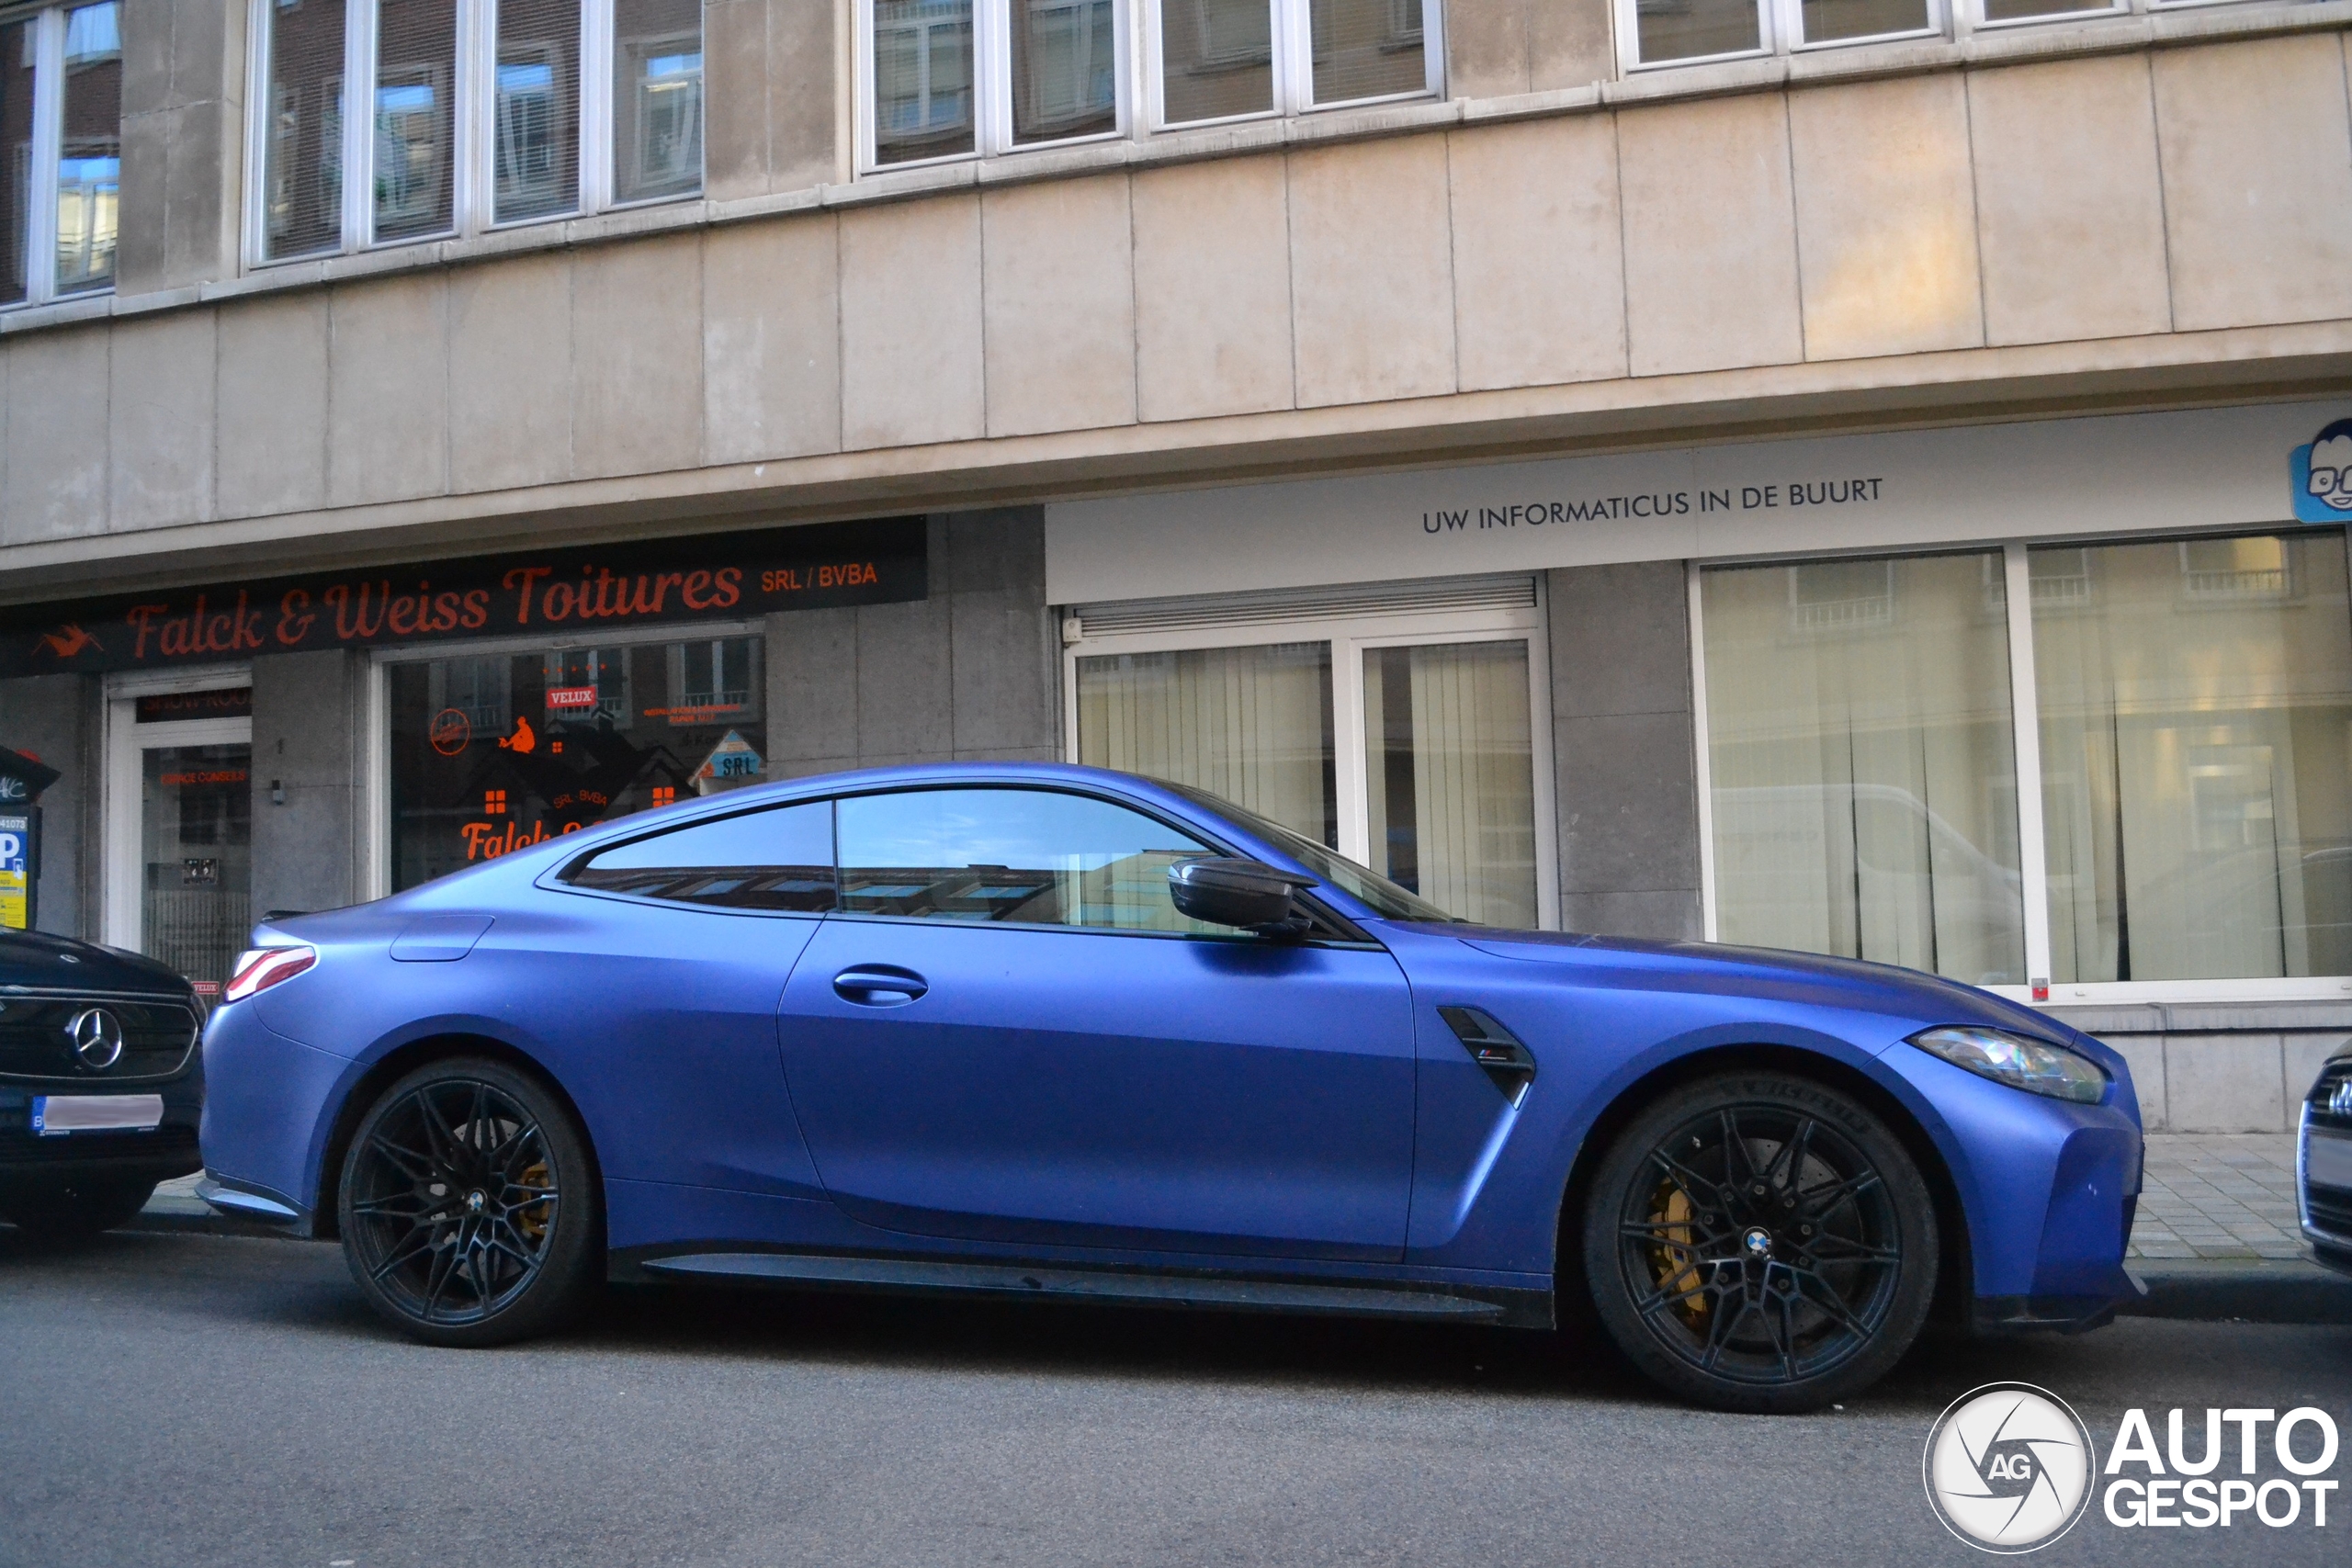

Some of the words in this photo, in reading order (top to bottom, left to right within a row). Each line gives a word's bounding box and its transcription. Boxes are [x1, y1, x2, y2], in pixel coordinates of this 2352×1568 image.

[1422, 511, 1470, 535] UW
[1478, 492, 1690, 529] INFORMATICUS
[1700, 489, 1731, 513] IN
[1742, 484, 1780, 509] DE
[1789, 478, 1883, 505] BUURT
[126, 588, 265, 660] Falck
[276, 588, 316, 644] &
[323, 579, 490, 640] Weiss
[502, 562, 742, 625] Toitures
[762, 570, 802, 592] SRL
[807, 567, 813, 589] /
[820, 561, 877, 588] BVBA
[551, 691, 593, 705] VELUX
[722, 756, 754, 777] SRL
[553, 793, 573, 809] SRL
[579, 789, 607, 807] BVBA
[0, 832, 20, 869] P
[194, 984, 217, 992] VELUX
[33, 1115, 43, 1128] B
